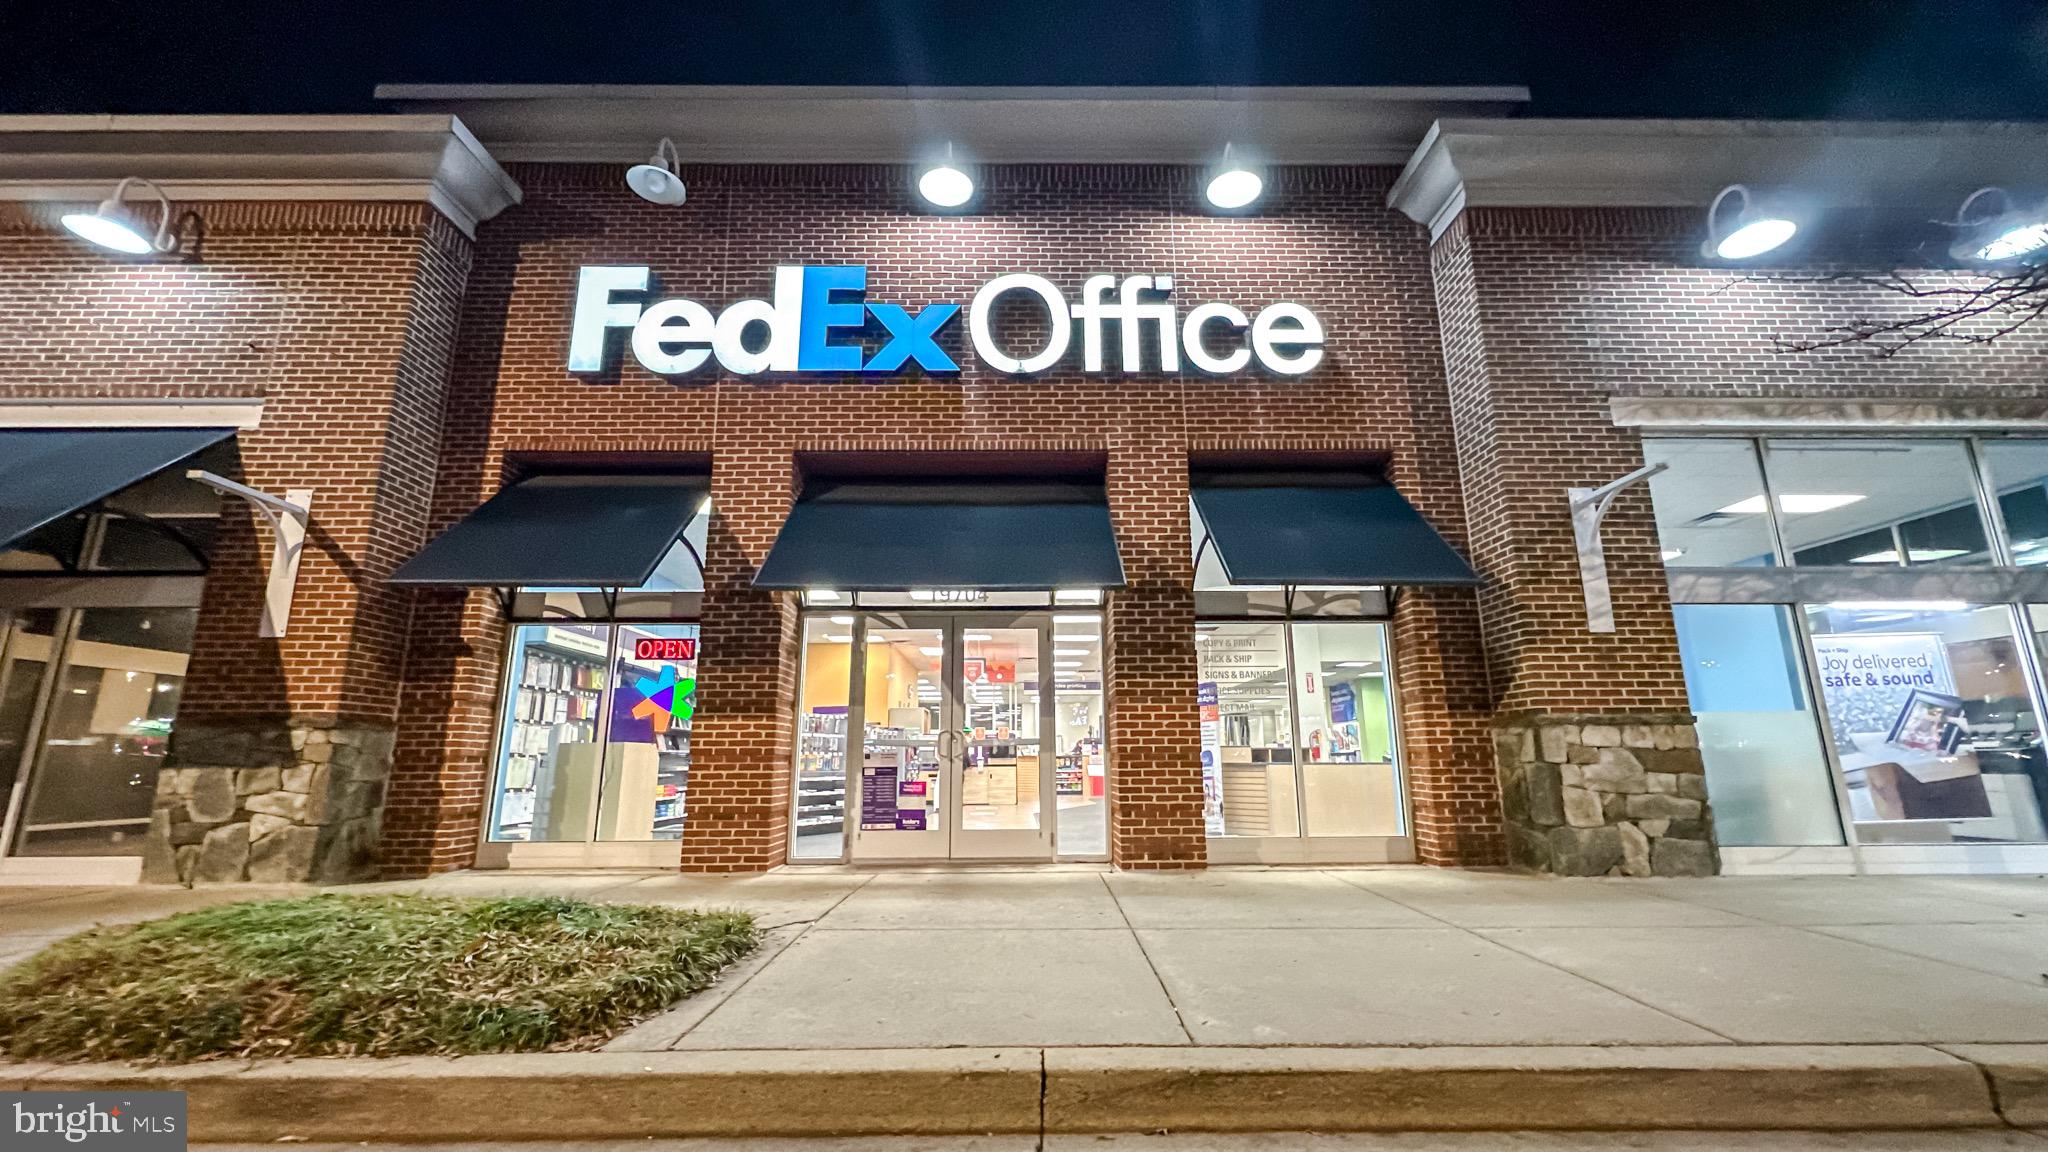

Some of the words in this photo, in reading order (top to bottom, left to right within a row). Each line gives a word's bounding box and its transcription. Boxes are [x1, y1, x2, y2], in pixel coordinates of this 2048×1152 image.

[568, 265, 961, 375] FedEx
[968, 272, 1326, 376] Office
[932, 589, 989, 602] 19704
[638, 640, 693, 658] OPEN
[1203, 639, 1225, 647] COPY
[1233, 639, 1257, 647] PRINT
[1203, 655, 1225, 663] PACK
[1225, 655, 1232, 663] &
[1233, 655, 1252, 663] SHIP
[1822, 656, 1848, 673] Joy
[1852, 653, 1933, 671] delivered,
[1204, 670, 1230, 679] SIGNS
[1230, 670, 1238, 678] &
[1239, 670, 1275, 678] BANNER
[1825, 672, 1862, 687] safe
[1865, 672, 1879, 686] &
[1882, 670, 1934, 686] sound
